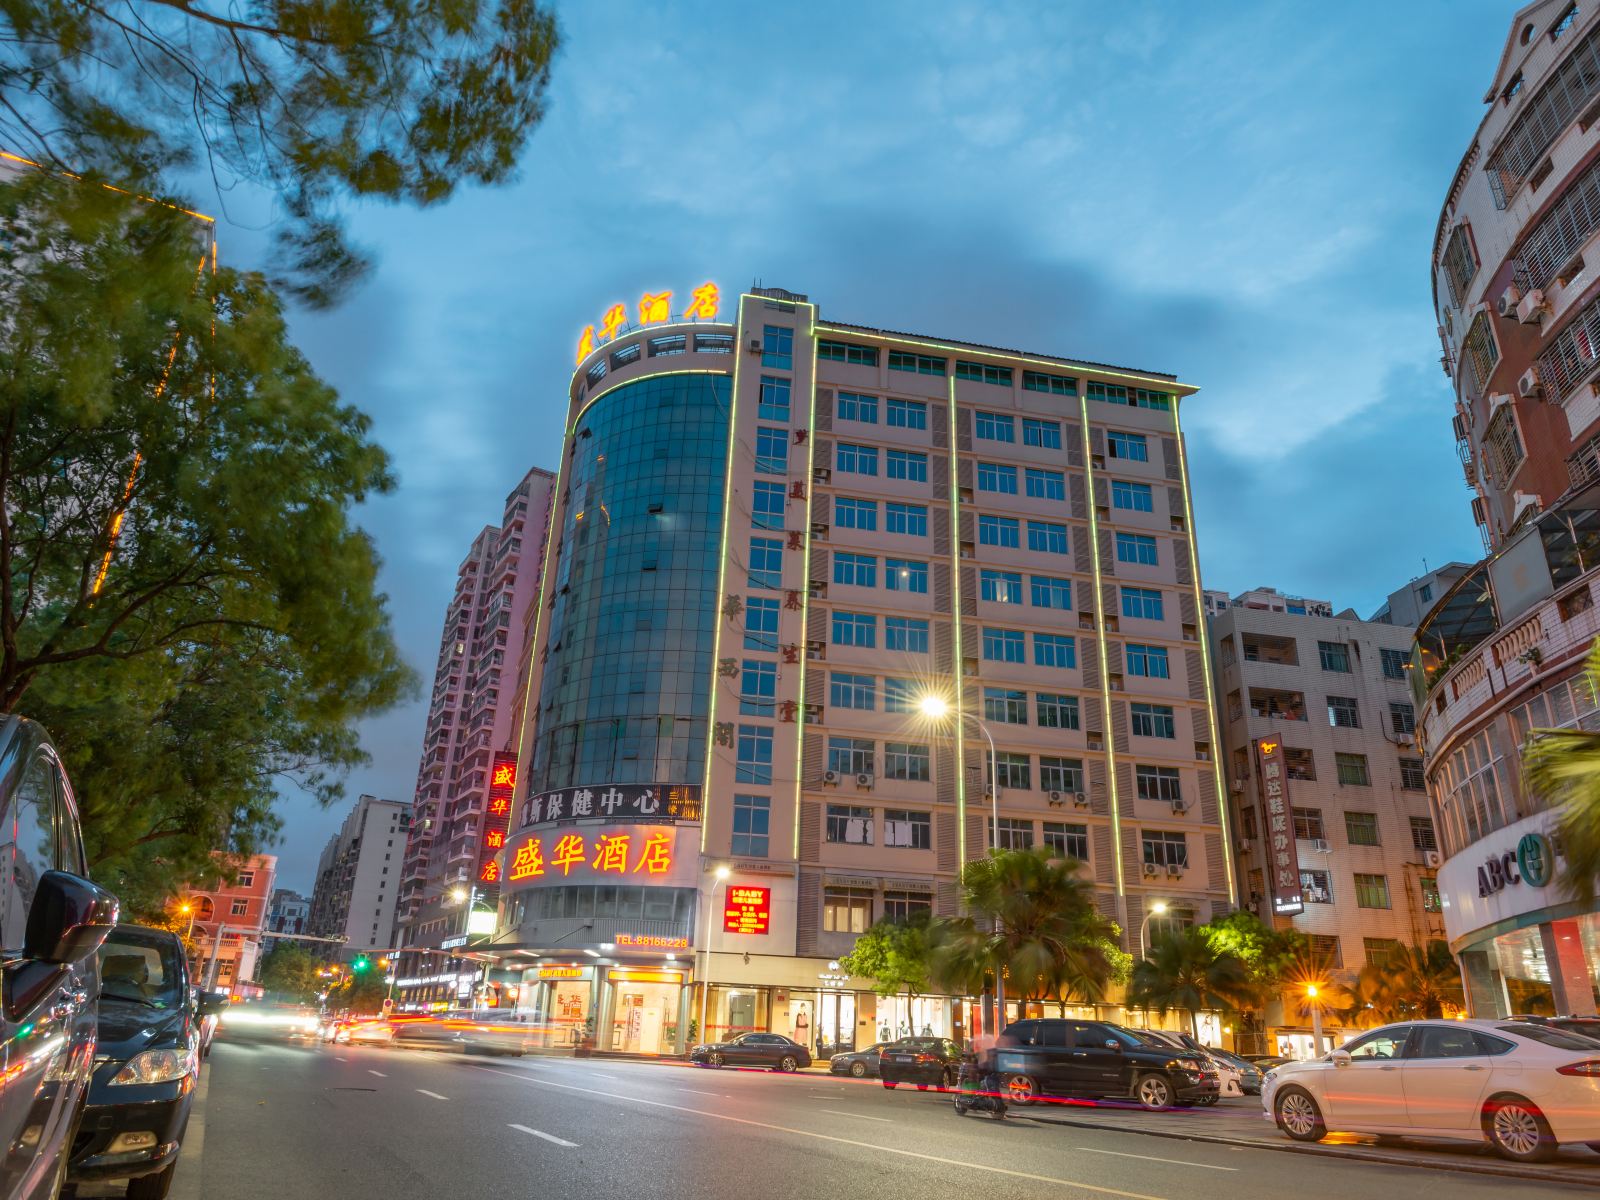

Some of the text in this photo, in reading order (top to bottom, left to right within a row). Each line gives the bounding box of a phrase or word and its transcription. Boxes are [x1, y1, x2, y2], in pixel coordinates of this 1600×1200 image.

[481, 765, 515, 881] 盛华酒店
[509, 832, 673, 882] 盛华酒店
[1478, 852, 1519, 897] ABC
